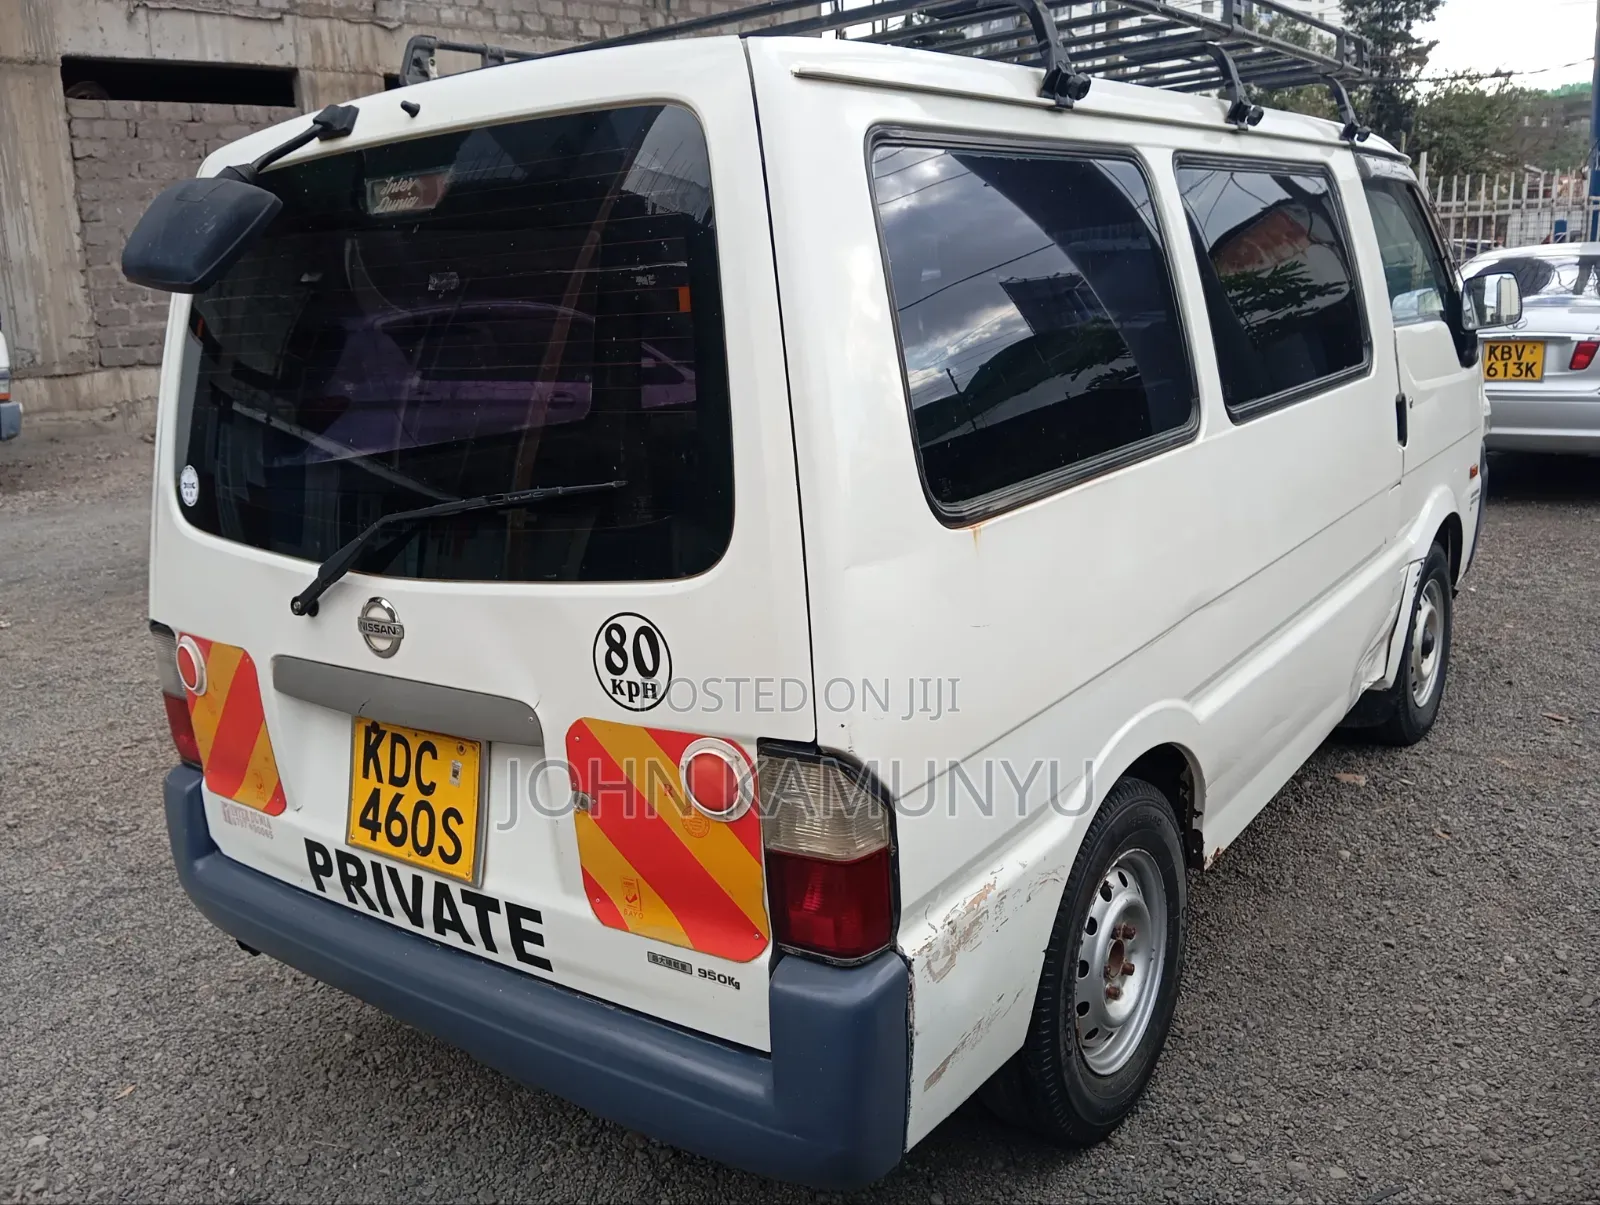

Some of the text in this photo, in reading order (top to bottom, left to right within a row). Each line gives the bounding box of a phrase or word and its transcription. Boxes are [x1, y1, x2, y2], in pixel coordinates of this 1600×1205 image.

[1486, 361, 1537, 378] 613K
[1487, 344, 1526, 361] KBV
[360, 621, 396, 635] NISSAN
[604, 622, 661, 680] 80
[362, 725, 438, 796] KDC
[359, 787, 464, 865] 460S
[304, 837, 553, 972] PRIVATE
